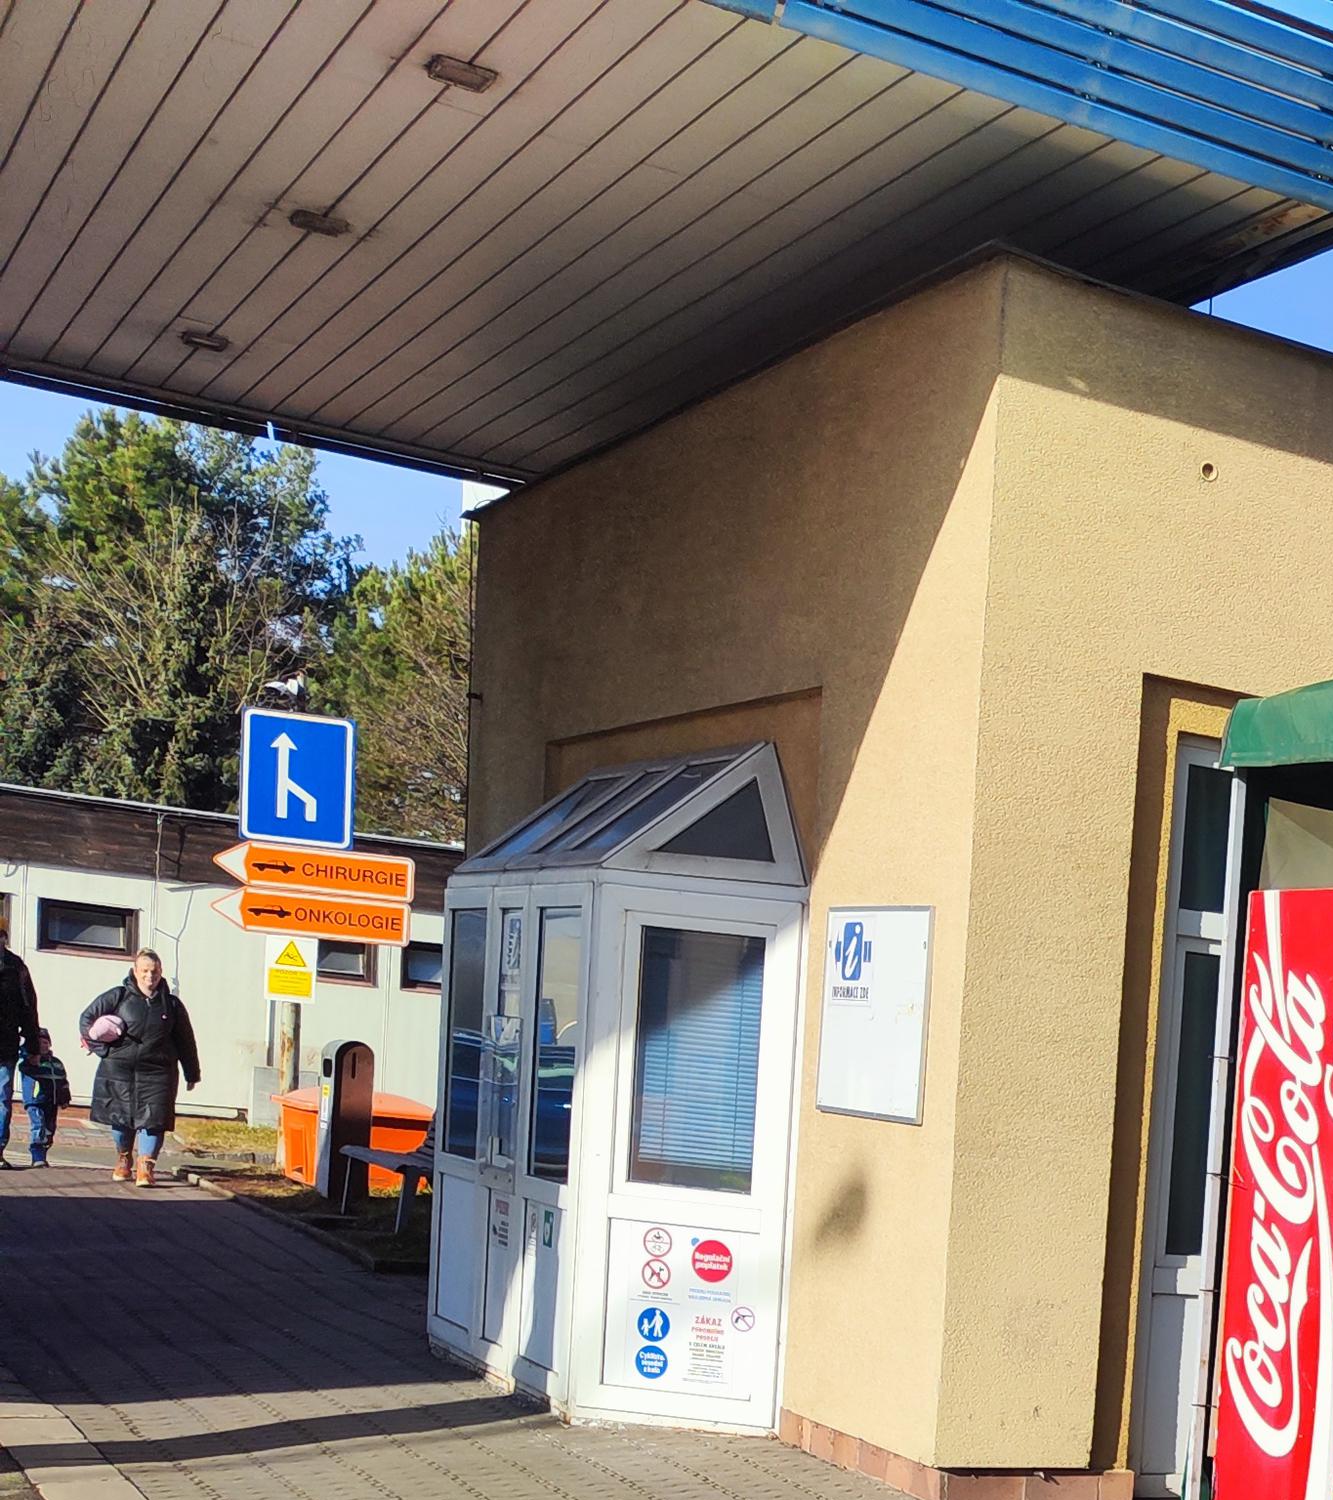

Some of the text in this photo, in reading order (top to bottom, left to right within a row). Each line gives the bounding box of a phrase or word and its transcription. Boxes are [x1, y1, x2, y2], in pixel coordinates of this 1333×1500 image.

[301, 862, 406, 888] CHIRURGIE
[294, 907, 401, 932] ONKOLOGIE
[1225, 950, 1328, 1458] Coca-Cola
[695, 1314, 722, 1327] ZÁKAZ
